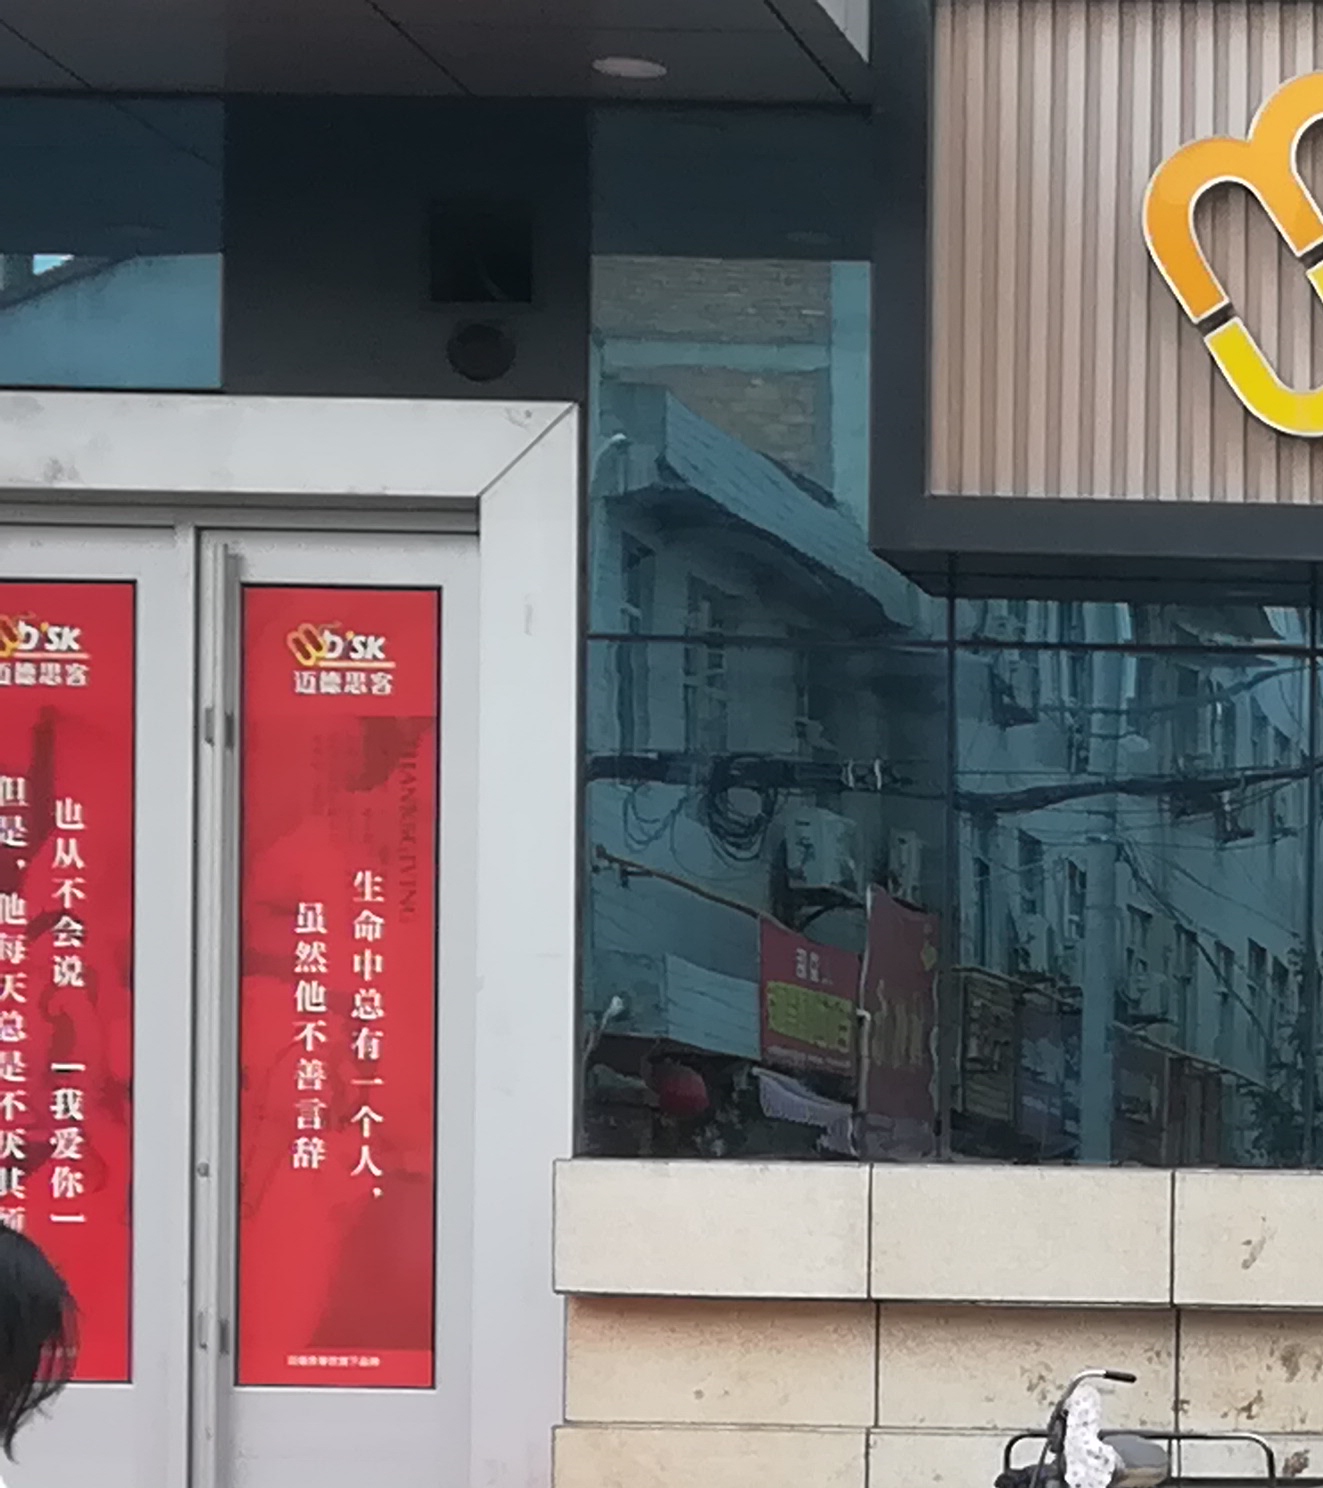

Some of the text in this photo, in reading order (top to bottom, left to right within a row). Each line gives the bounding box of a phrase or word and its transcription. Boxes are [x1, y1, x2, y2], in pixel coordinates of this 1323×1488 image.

[293, 670, 395, 696] 迈德思客
[292, 902, 328, 1170] 虽然他不善言辞
